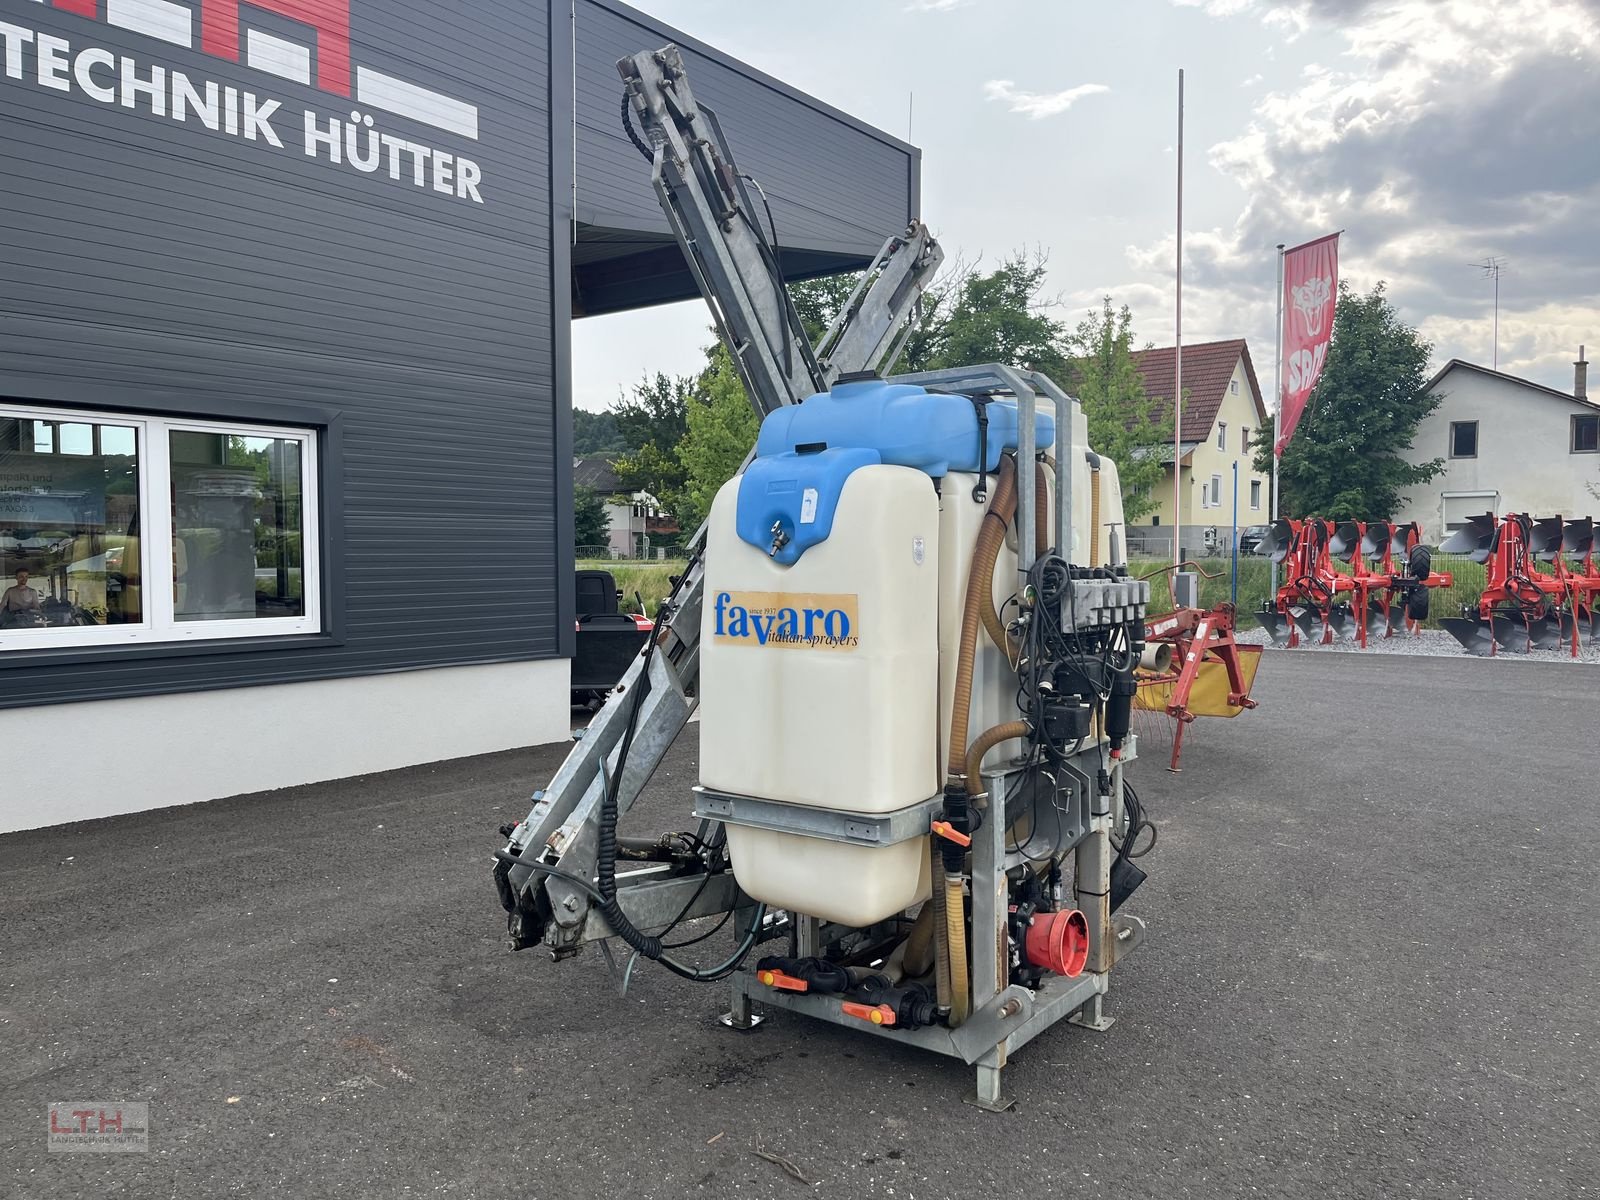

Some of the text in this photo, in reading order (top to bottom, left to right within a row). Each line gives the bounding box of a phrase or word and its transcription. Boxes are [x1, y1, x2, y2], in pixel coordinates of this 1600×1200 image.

[0, 22, 284, 148] TECHNIK
[304, 110, 484, 204] HÜTTER
[714, 592, 850, 645] favaro
[768, 630, 859, 648] italian sprayers
